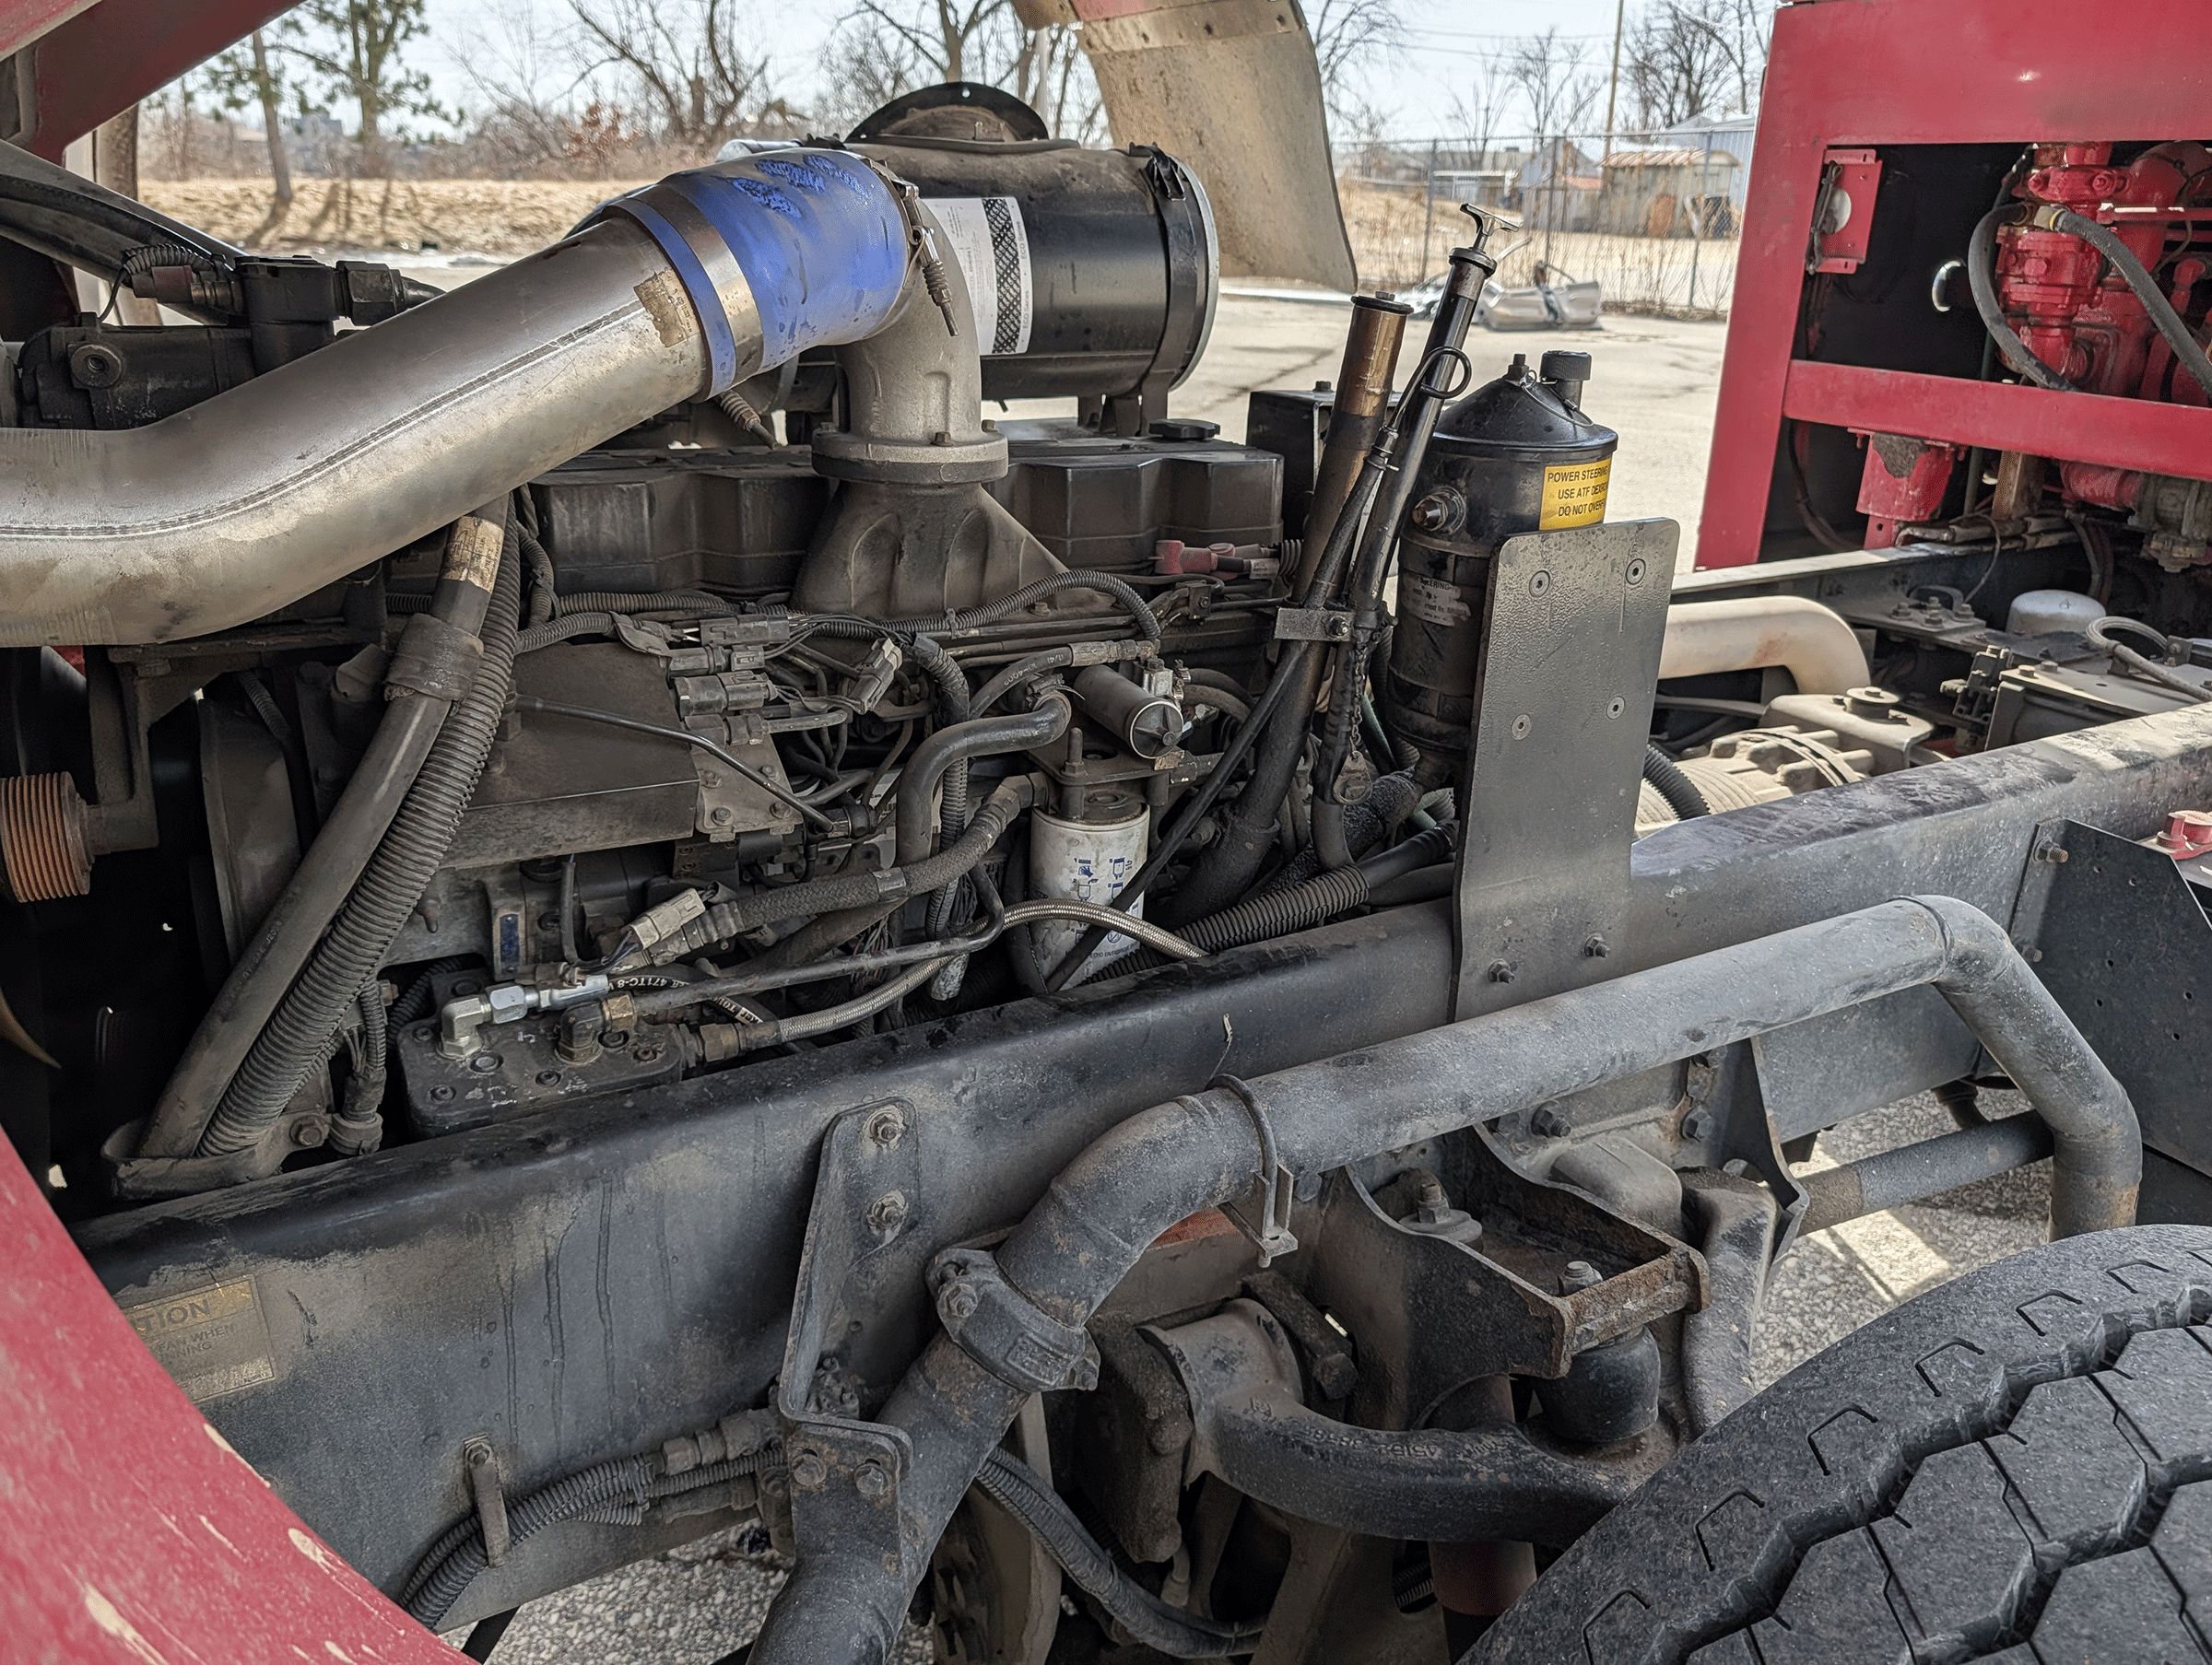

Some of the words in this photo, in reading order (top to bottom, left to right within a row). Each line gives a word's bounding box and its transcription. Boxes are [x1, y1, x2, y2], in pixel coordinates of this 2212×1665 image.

[1016, 220, 1025, 242] Series
[1547, 471, 1581, 483] POWER
[1558, 488, 1575, 499] USE
[1576, 487, 1591, 498] ATF
[1559, 506, 1571, 517] DO
[1572, 503, 1588, 515] NOT
[617, 977, 668, 989] 471TC-8
